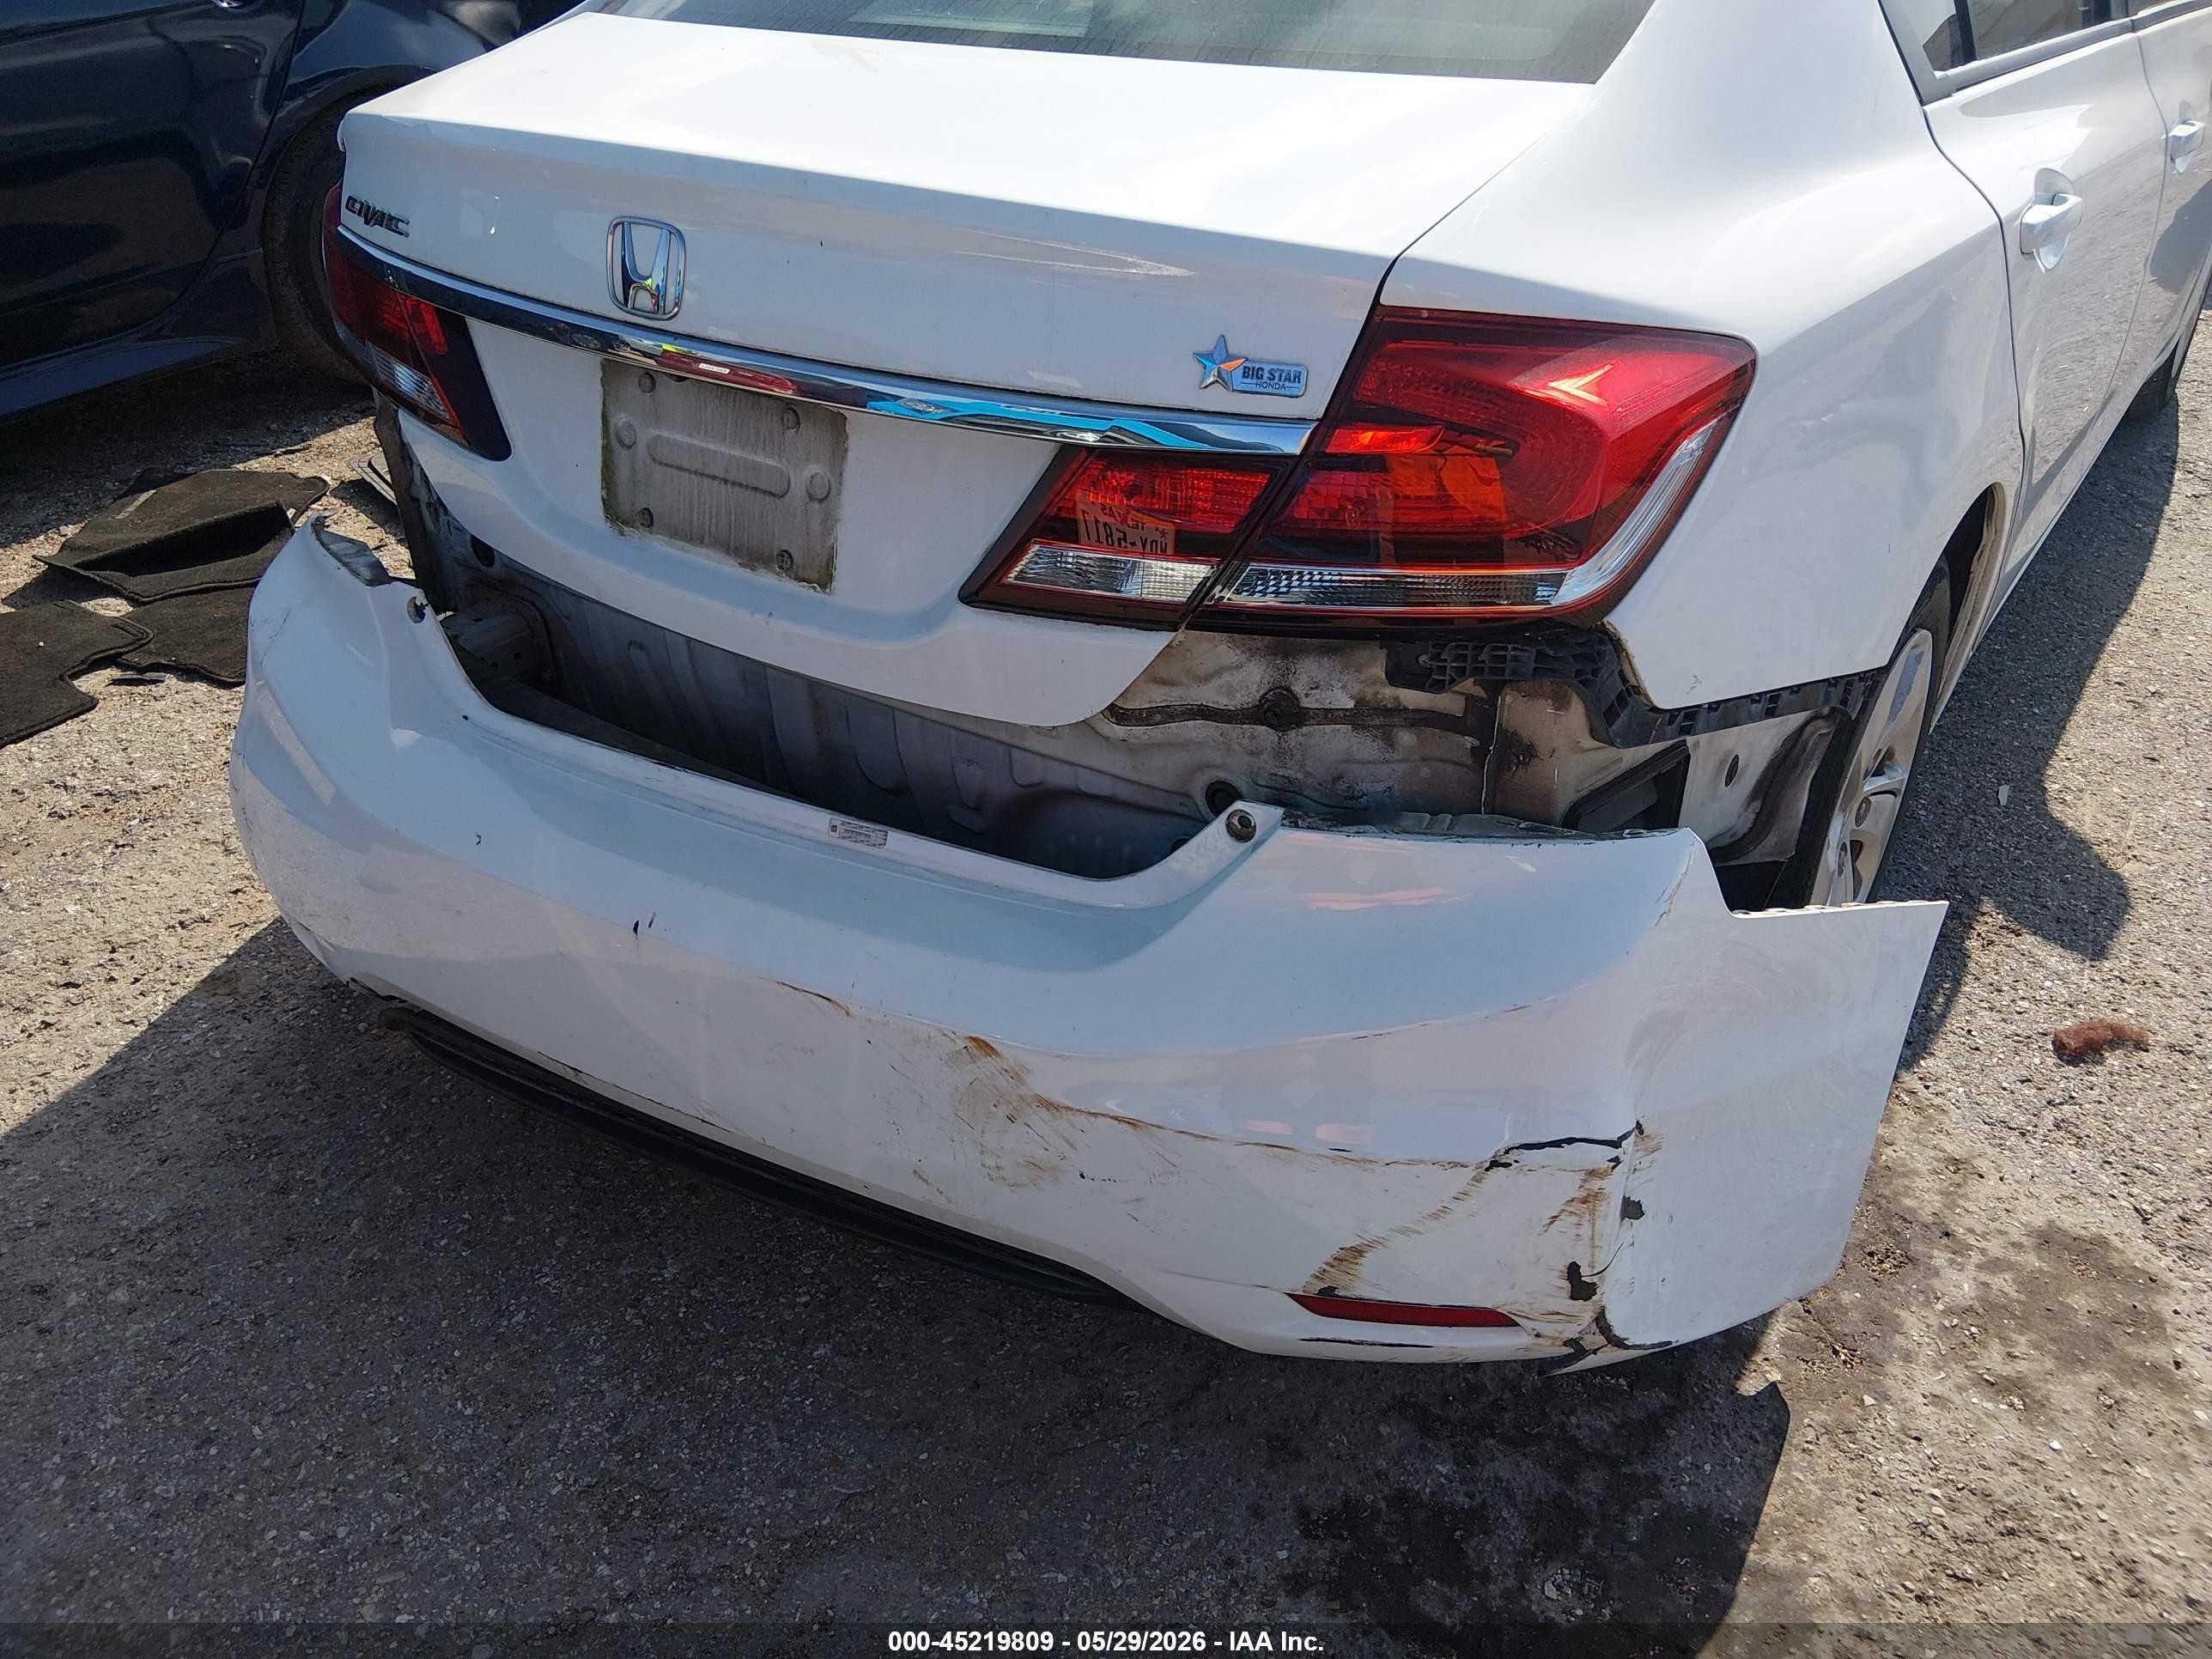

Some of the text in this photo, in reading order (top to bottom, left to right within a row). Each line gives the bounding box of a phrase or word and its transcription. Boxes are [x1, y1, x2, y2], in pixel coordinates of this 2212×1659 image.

[345, 194, 410, 238] CIVIC
[1242, 365, 1303, 385] BIG STAR
[1255, 380, 1286, 391] HONDA
